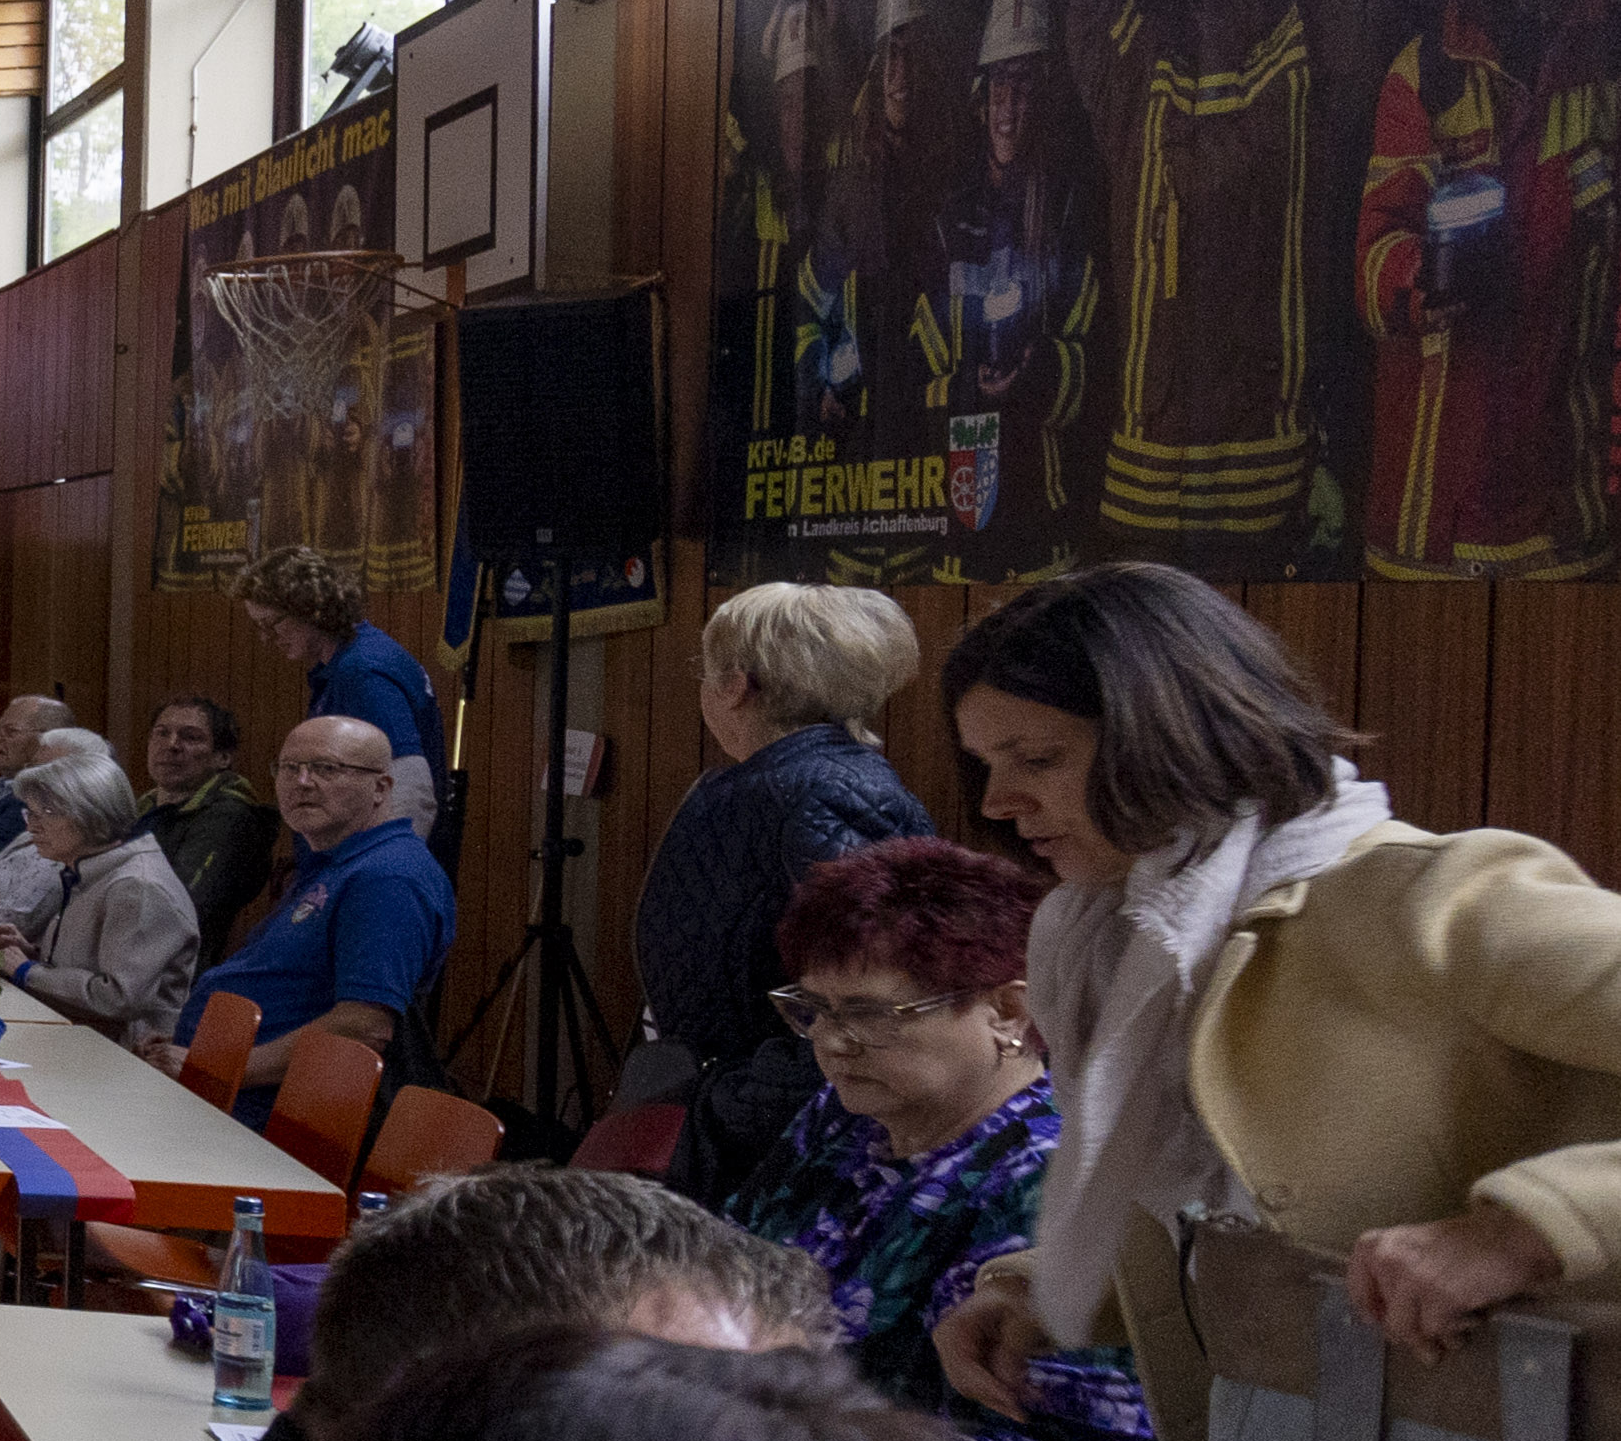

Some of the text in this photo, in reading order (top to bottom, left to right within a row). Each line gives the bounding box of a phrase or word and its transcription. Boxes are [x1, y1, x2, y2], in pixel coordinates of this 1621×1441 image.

[189, 188, 219, 231] Was
[222, 167, 252, 216] mit
[254, 125, 337, 202] Blaulicht
[747, 433, 835, 470] KFV-B.de
[745, 455, 947, 521] FEUERWEHR
